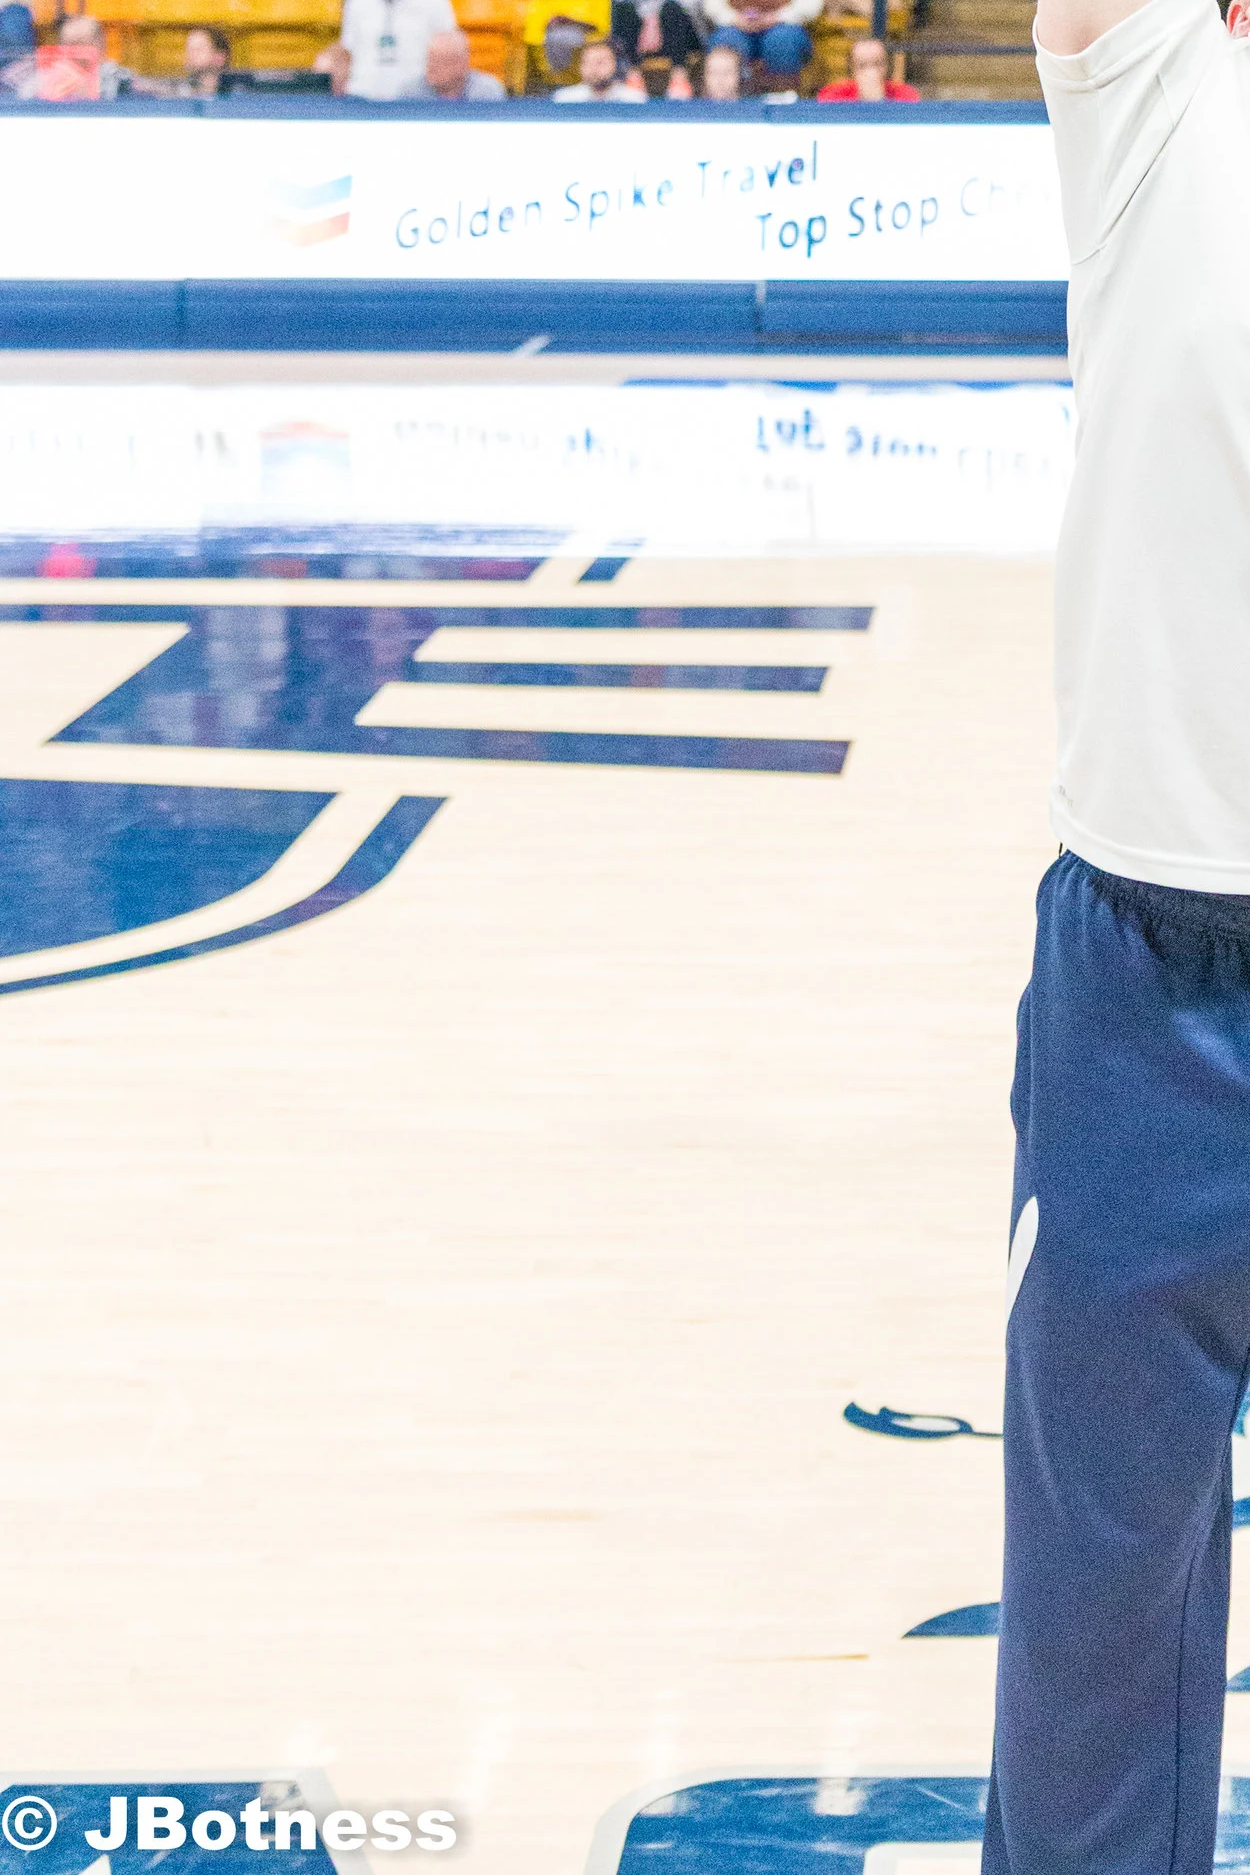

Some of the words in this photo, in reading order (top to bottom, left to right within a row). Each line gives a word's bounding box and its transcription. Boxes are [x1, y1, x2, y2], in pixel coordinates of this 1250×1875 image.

[394, 195, 543, 250] Golden
[564, 170, 675, 231] Spike
[696, 139, 819, 200] Travel
[755, 211, 828, 259] Top
[847, 195, 940, 238] Stop
